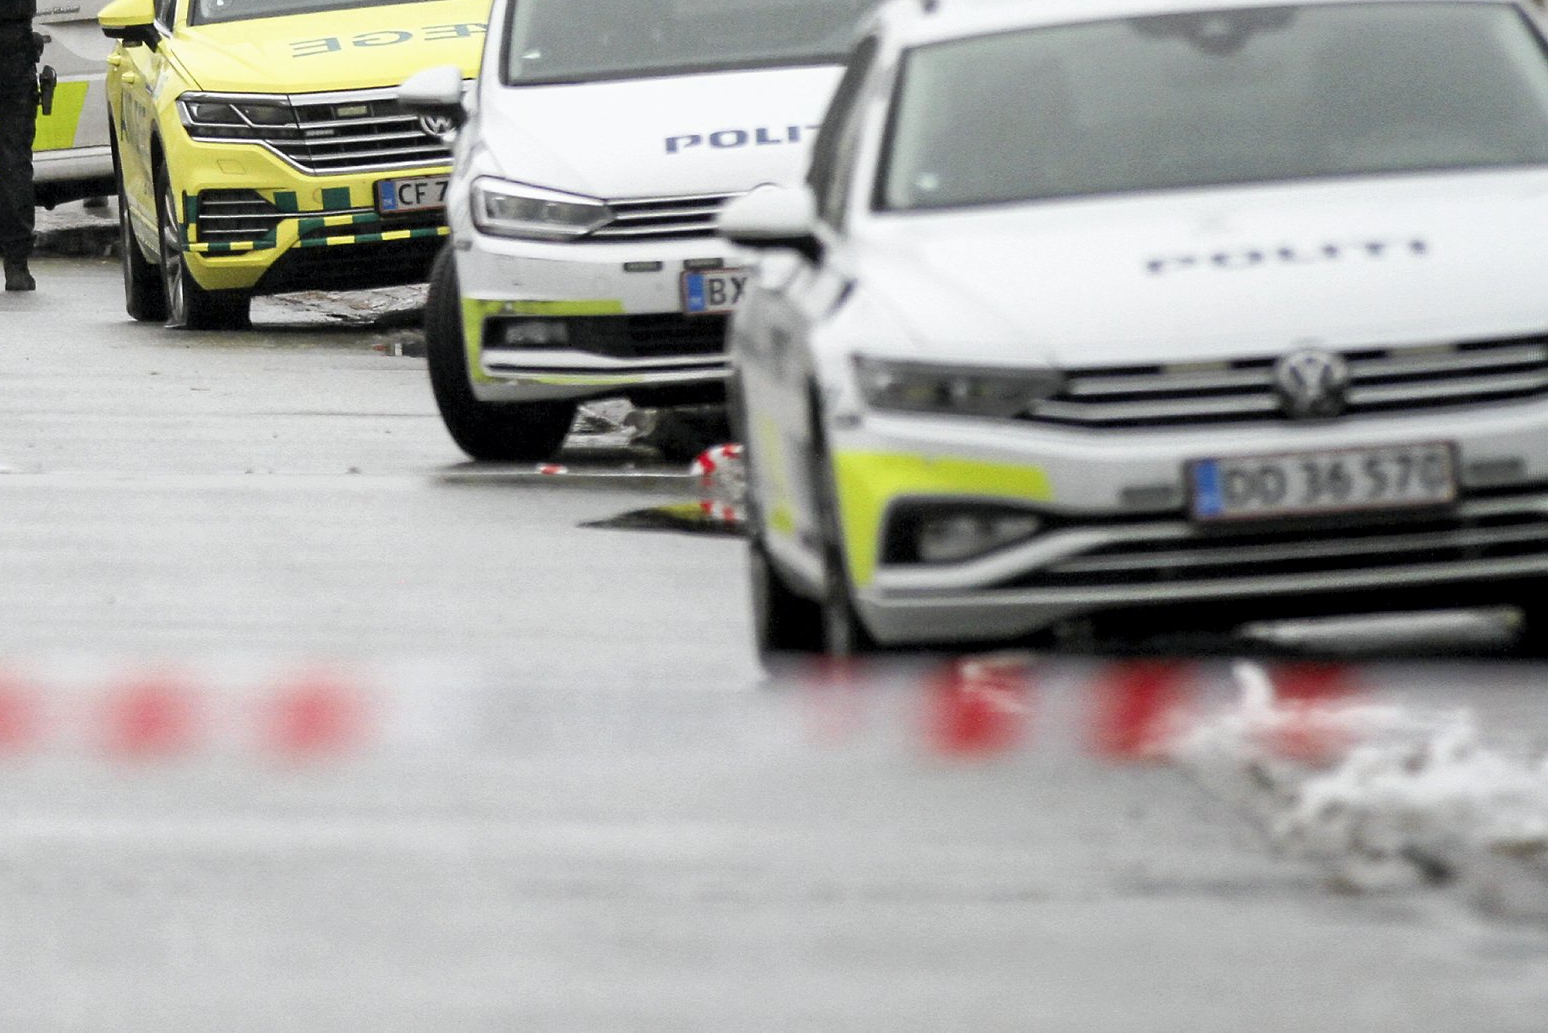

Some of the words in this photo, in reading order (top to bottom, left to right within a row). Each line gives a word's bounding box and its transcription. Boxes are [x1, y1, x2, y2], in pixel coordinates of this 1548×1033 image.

[665, 124, 821, 154] POLI
[398, 182, 428, 205] CF
[436, 181, 449, 202] 7
[1145, 239, 1429, 276] POLITI
